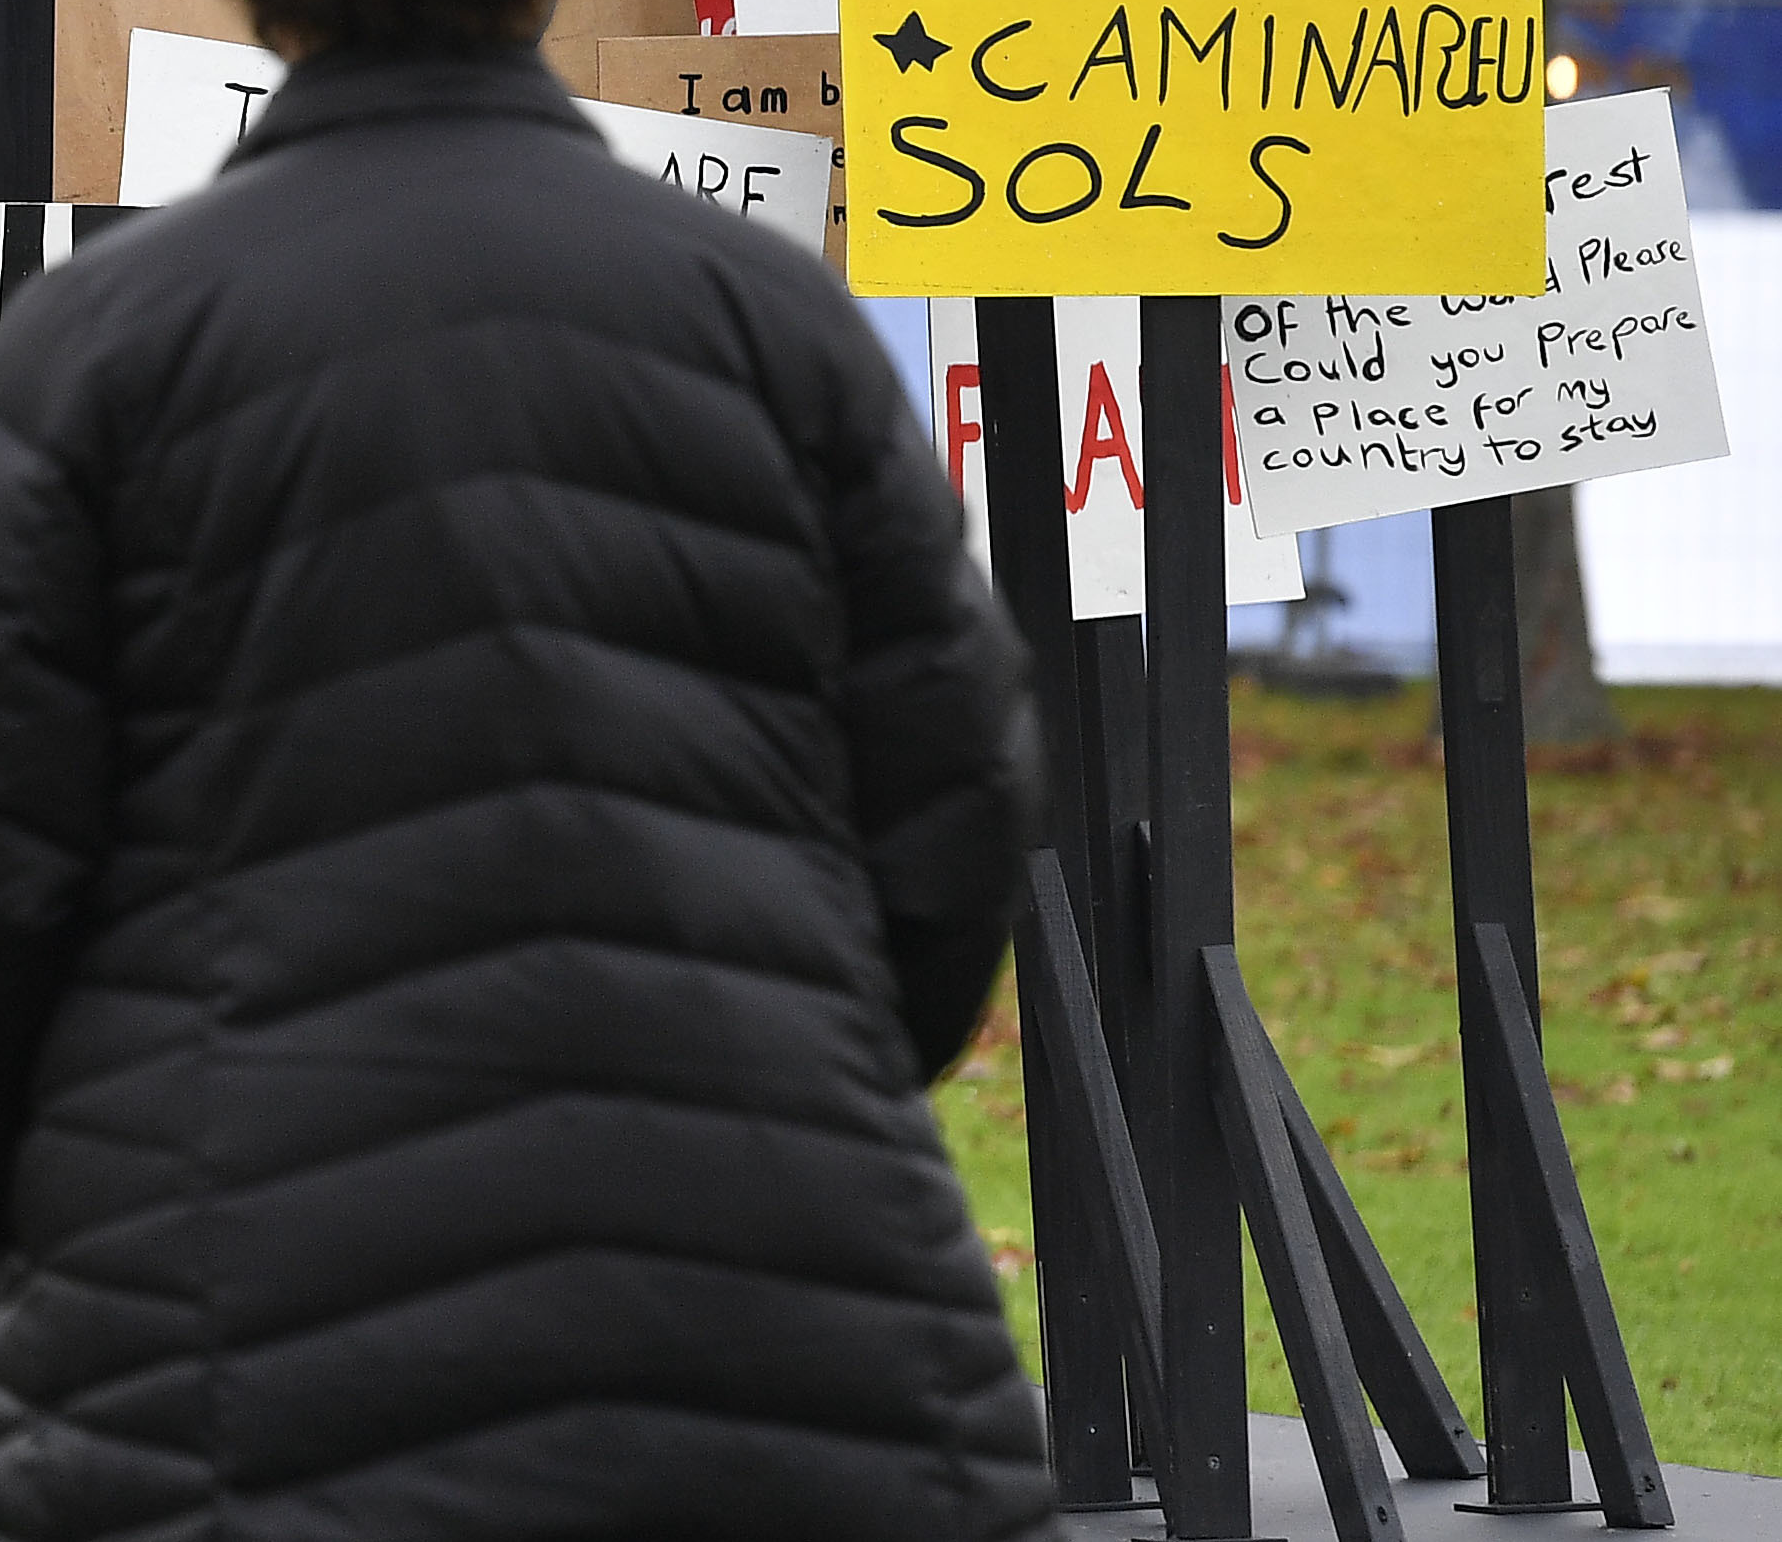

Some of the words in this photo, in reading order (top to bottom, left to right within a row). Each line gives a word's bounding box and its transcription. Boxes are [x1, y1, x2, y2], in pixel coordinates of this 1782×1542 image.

[971, 3, 1536, 118] CAMINAREU
[722, 84, 789, 115] am
[876, 115, 1312, 249] SOLS
[1578, 237, 1688, 285] Please
[1243, 329, 1387, 384] Could
[1430, 341, 1505, 389] you
[1253, 404, 1287, 426] a
[1557, 375, 1612, 410] my
[1262, 432, 1466, 477] country
[1483, 434, 1542, 467] to
[1559, 407, 1658, 453] stay
